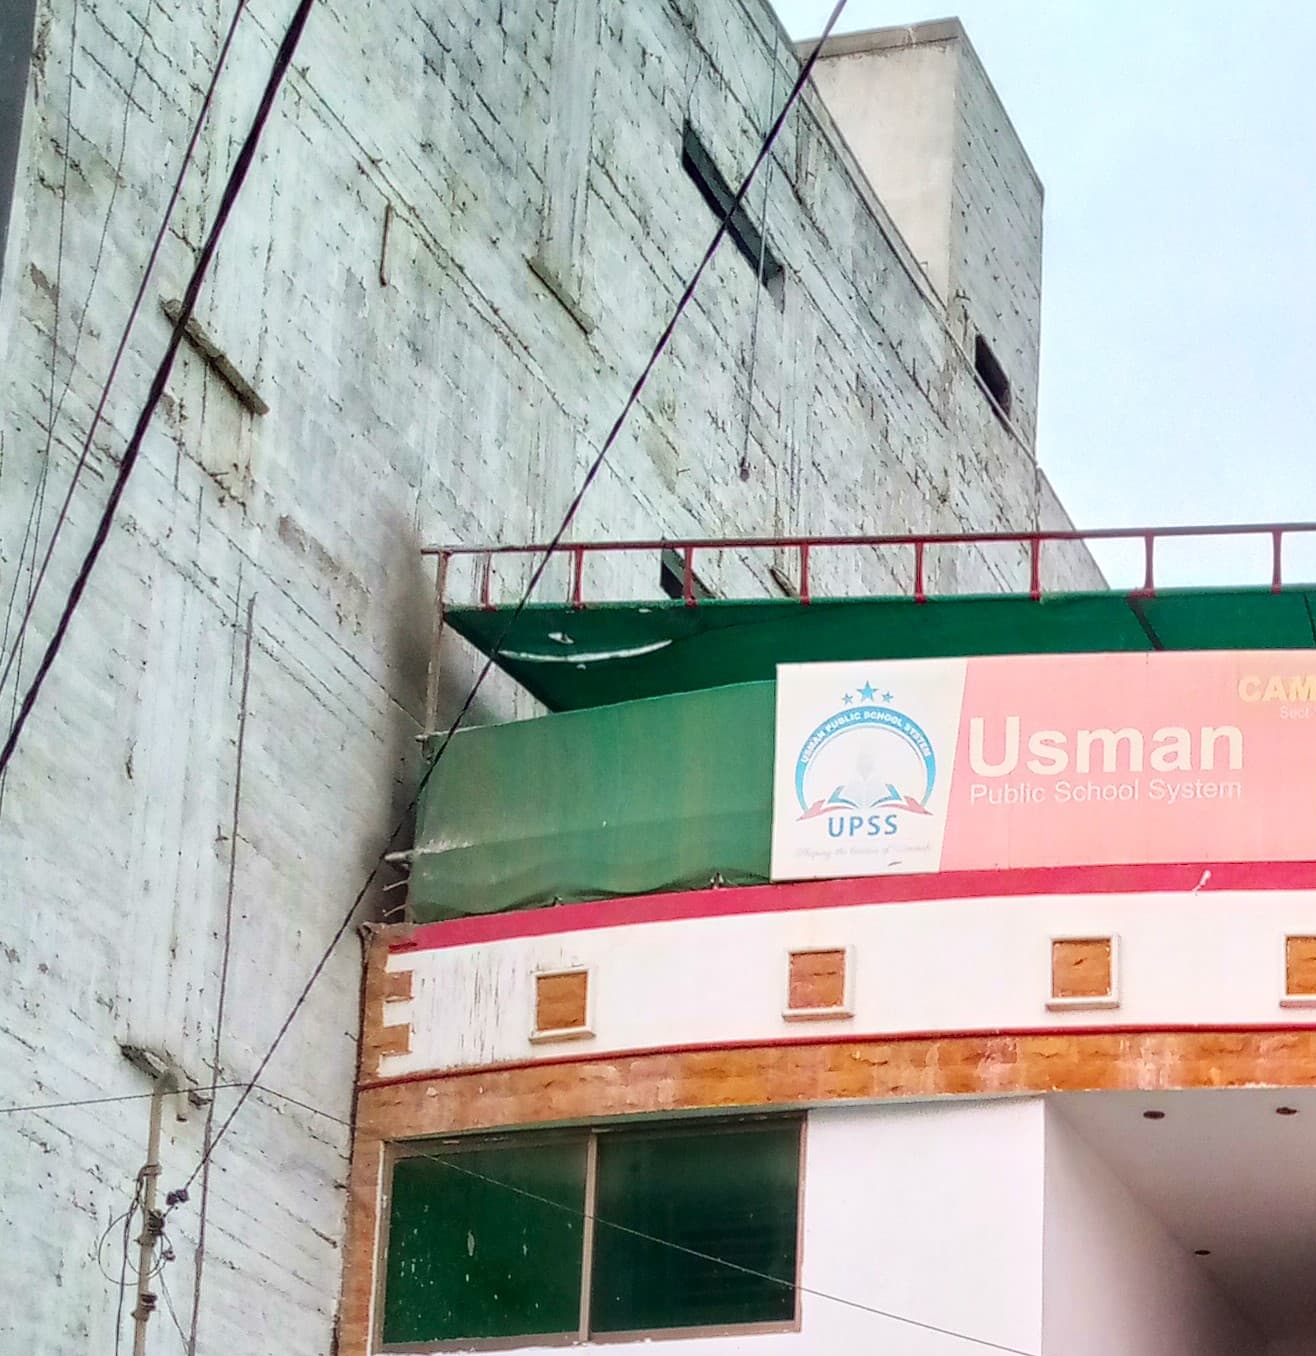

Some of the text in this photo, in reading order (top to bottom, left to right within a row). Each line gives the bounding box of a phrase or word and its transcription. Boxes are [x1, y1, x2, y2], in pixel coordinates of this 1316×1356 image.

[825, 711, 862, 733] PUBLIC
[863, 710, 904, 727] SCHOOL
[904, 723, 932, 758] SYSTEM
[968, 715, 1244, 778] Usman
[970, 777, 1242, 805] Public School System
[827, 814, 899, 838] UPSS
